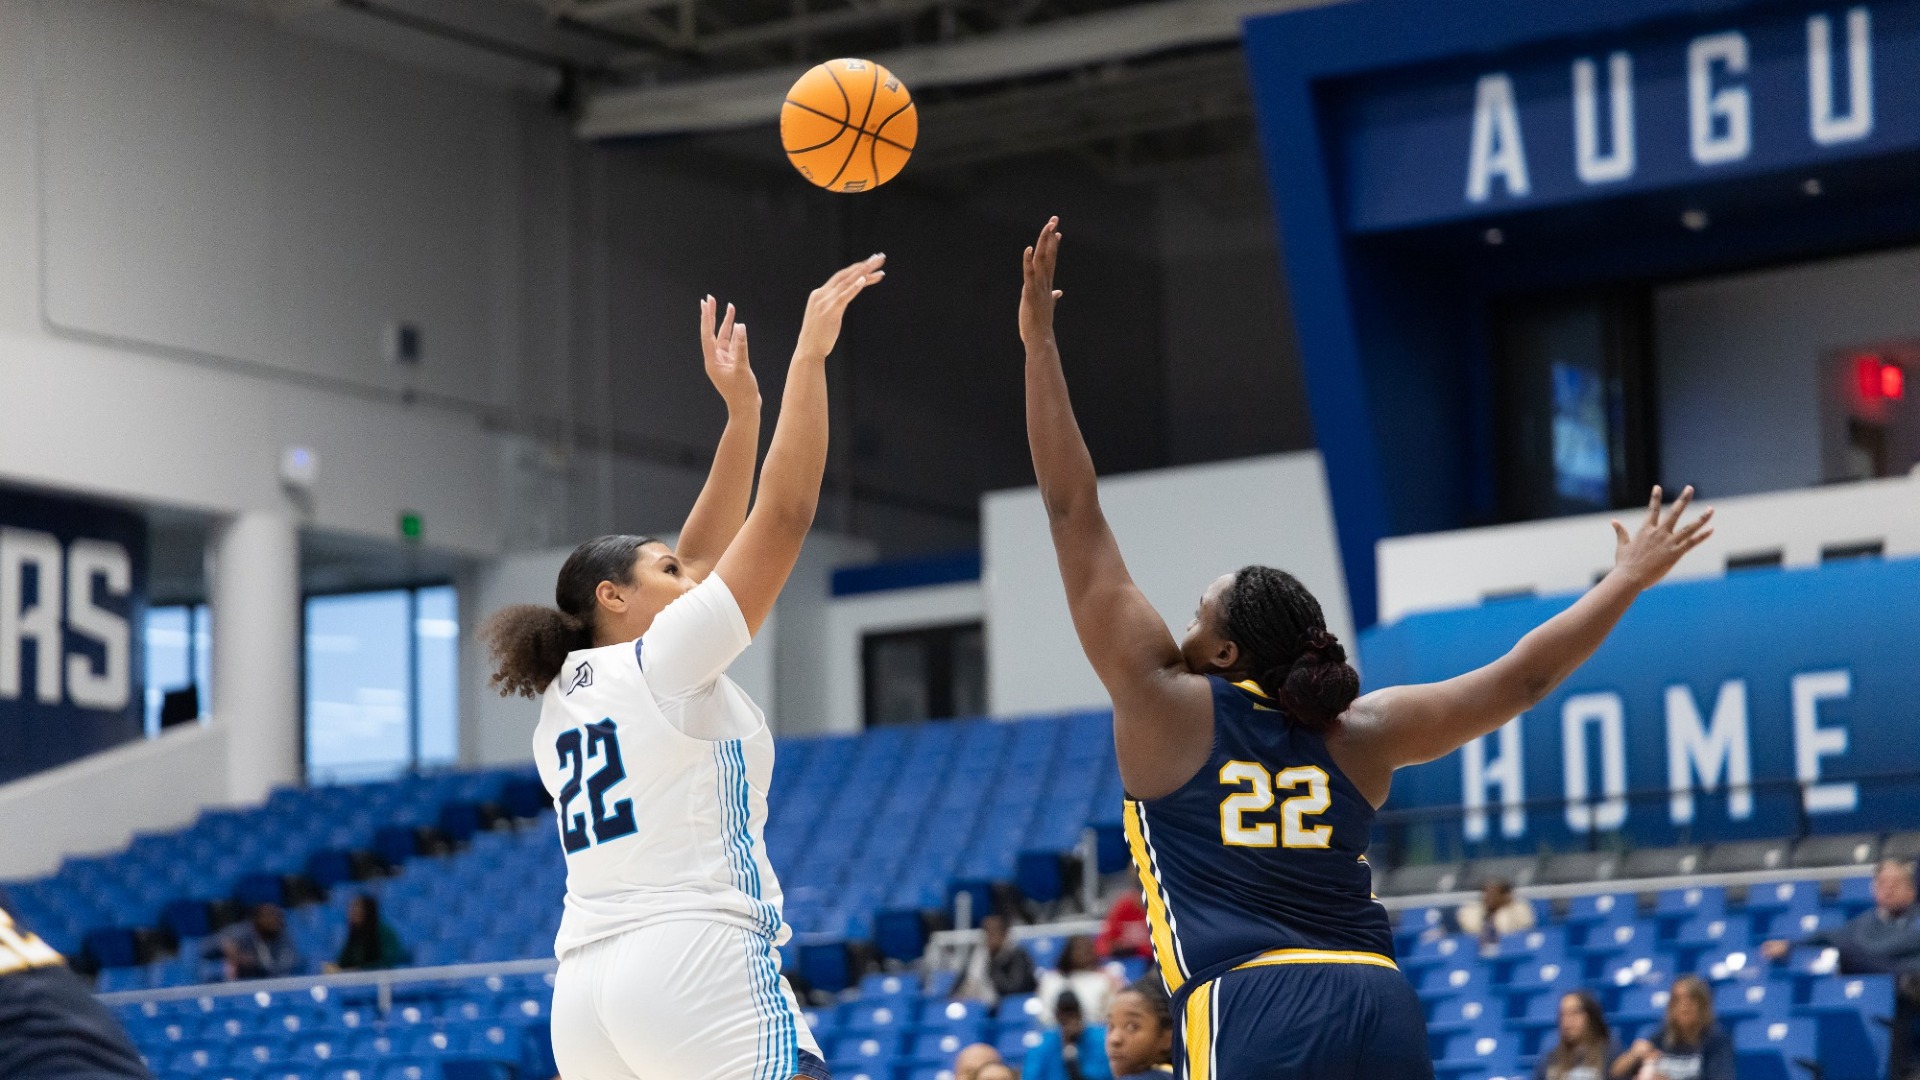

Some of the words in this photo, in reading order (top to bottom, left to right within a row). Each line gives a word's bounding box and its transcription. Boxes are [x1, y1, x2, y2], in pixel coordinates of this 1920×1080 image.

[1465, 6, 1875, 203] AUGU
[0, 526, 132, 711] RS
[555, 717, 639, 856] 22
[1219, 759, 1334, 849] 22
[1460, 667, 1858, 842] HOME
